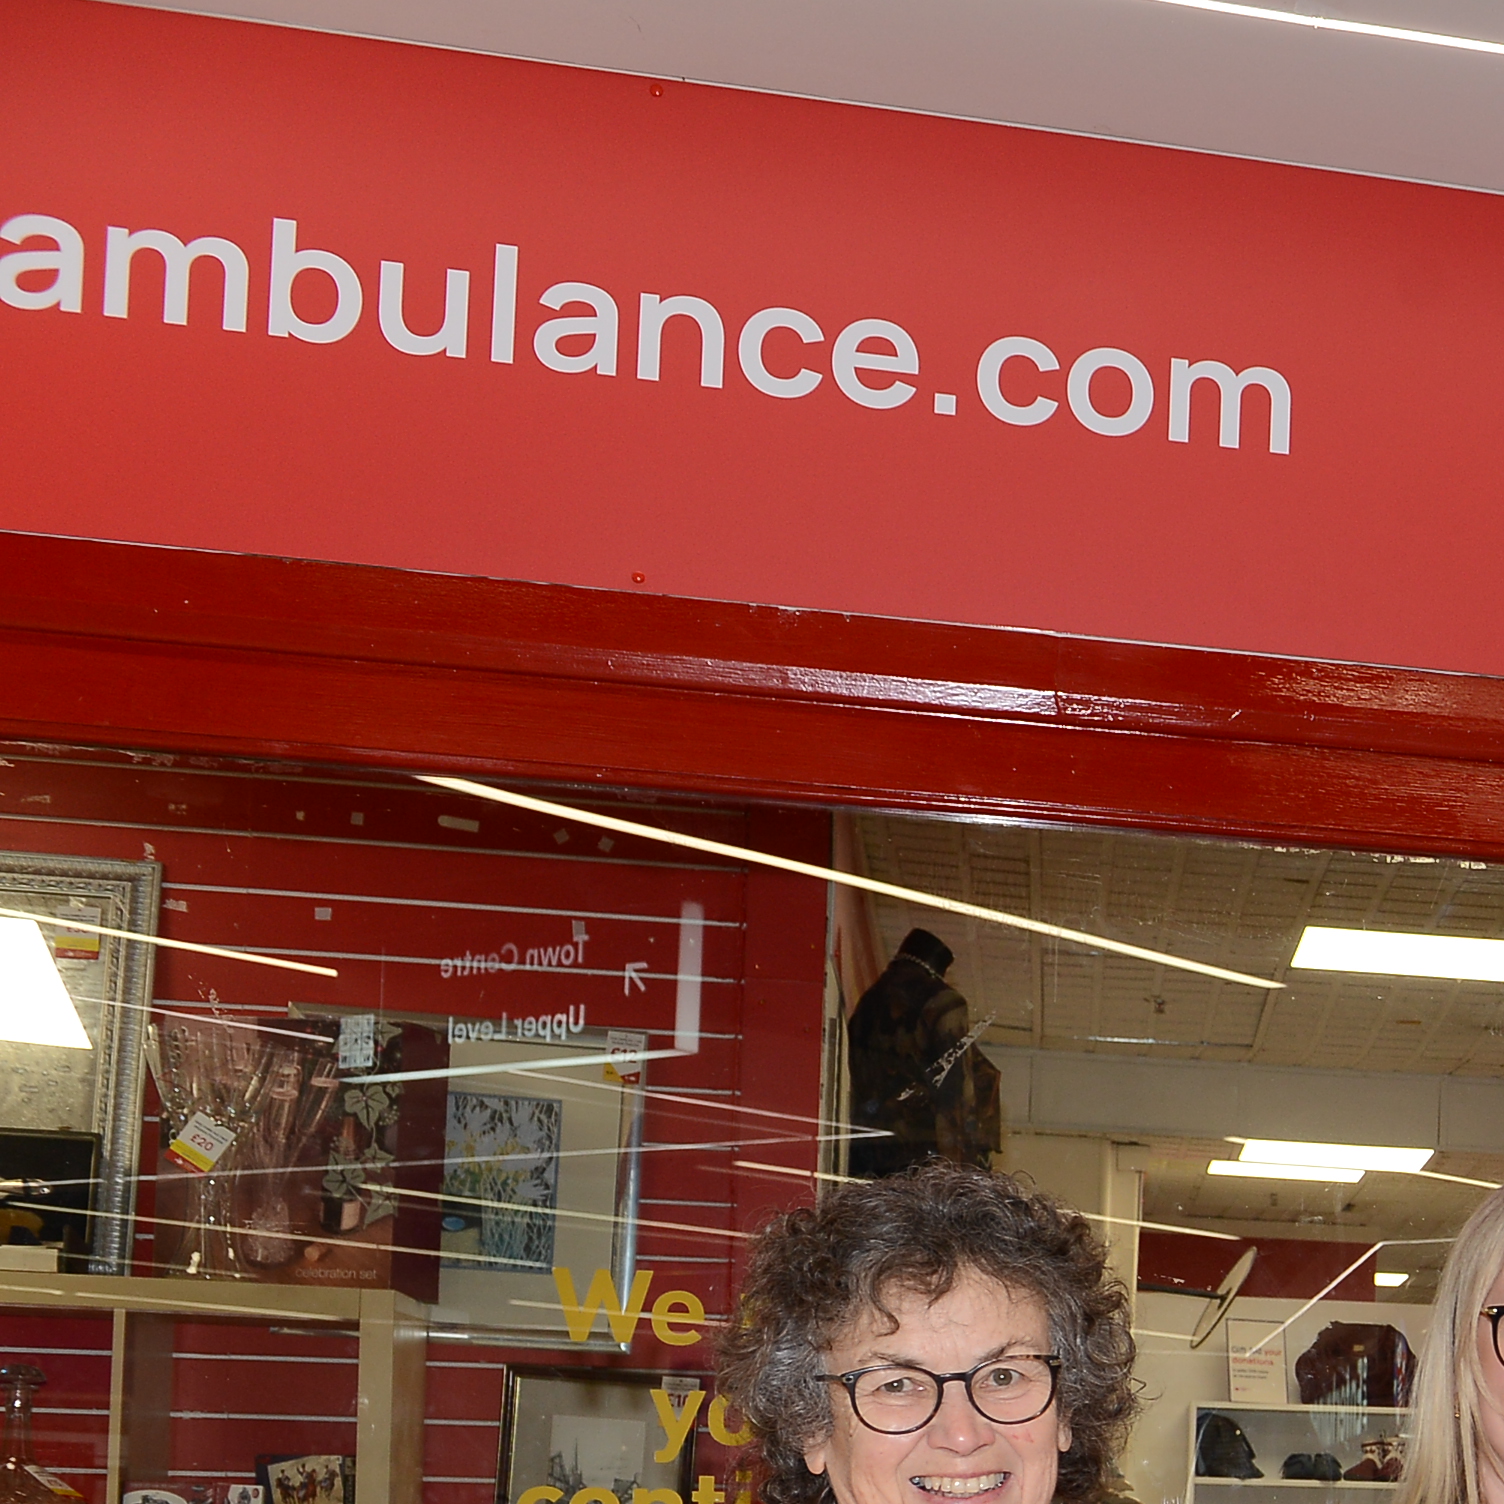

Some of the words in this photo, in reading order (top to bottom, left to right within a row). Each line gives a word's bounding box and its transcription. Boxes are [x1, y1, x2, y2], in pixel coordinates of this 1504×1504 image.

[0, 214, 1293, 455] ambulance.com
[189, 1133, 214, 1152] £20
[295, 1267, 356, 1280] celebration
[359, 1269, 377, 1280] set
[553, 1267, 705, 1346] We
